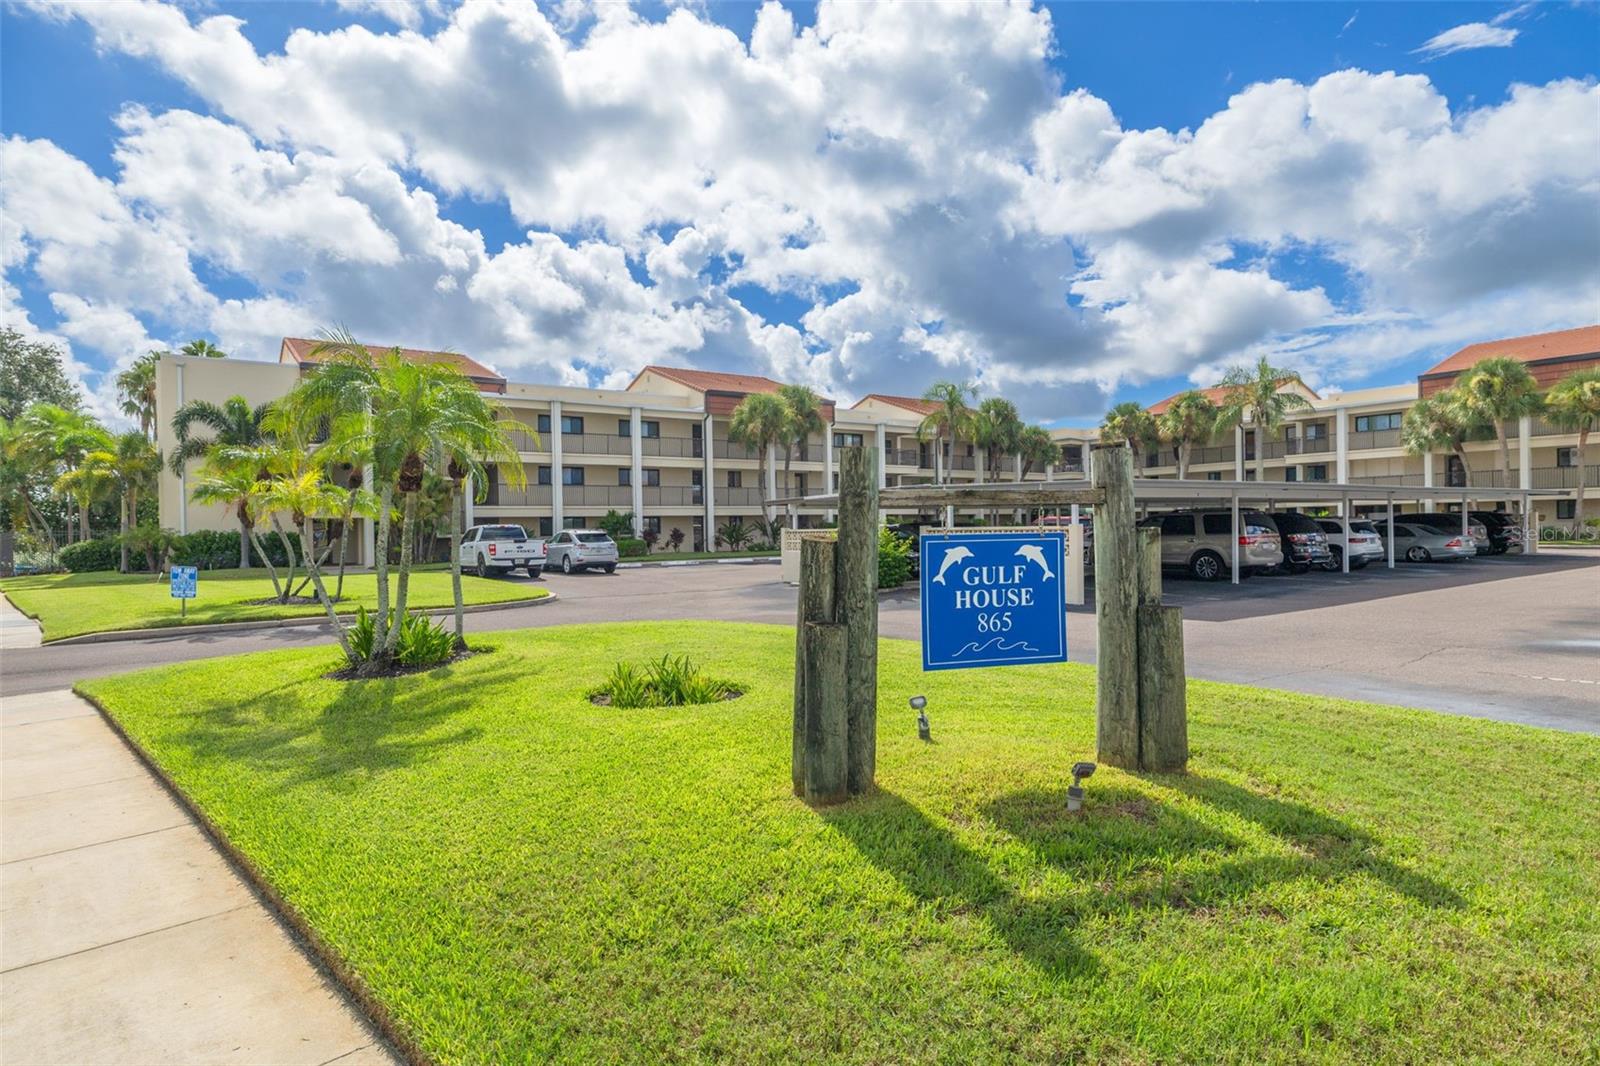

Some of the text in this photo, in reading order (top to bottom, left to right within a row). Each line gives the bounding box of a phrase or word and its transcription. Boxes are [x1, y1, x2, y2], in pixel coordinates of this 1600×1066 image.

[963, 565, 1026, 586] GULF
[955, 588, 1034, 609] HOUSE
[977, 612, 1013, 633] 865
